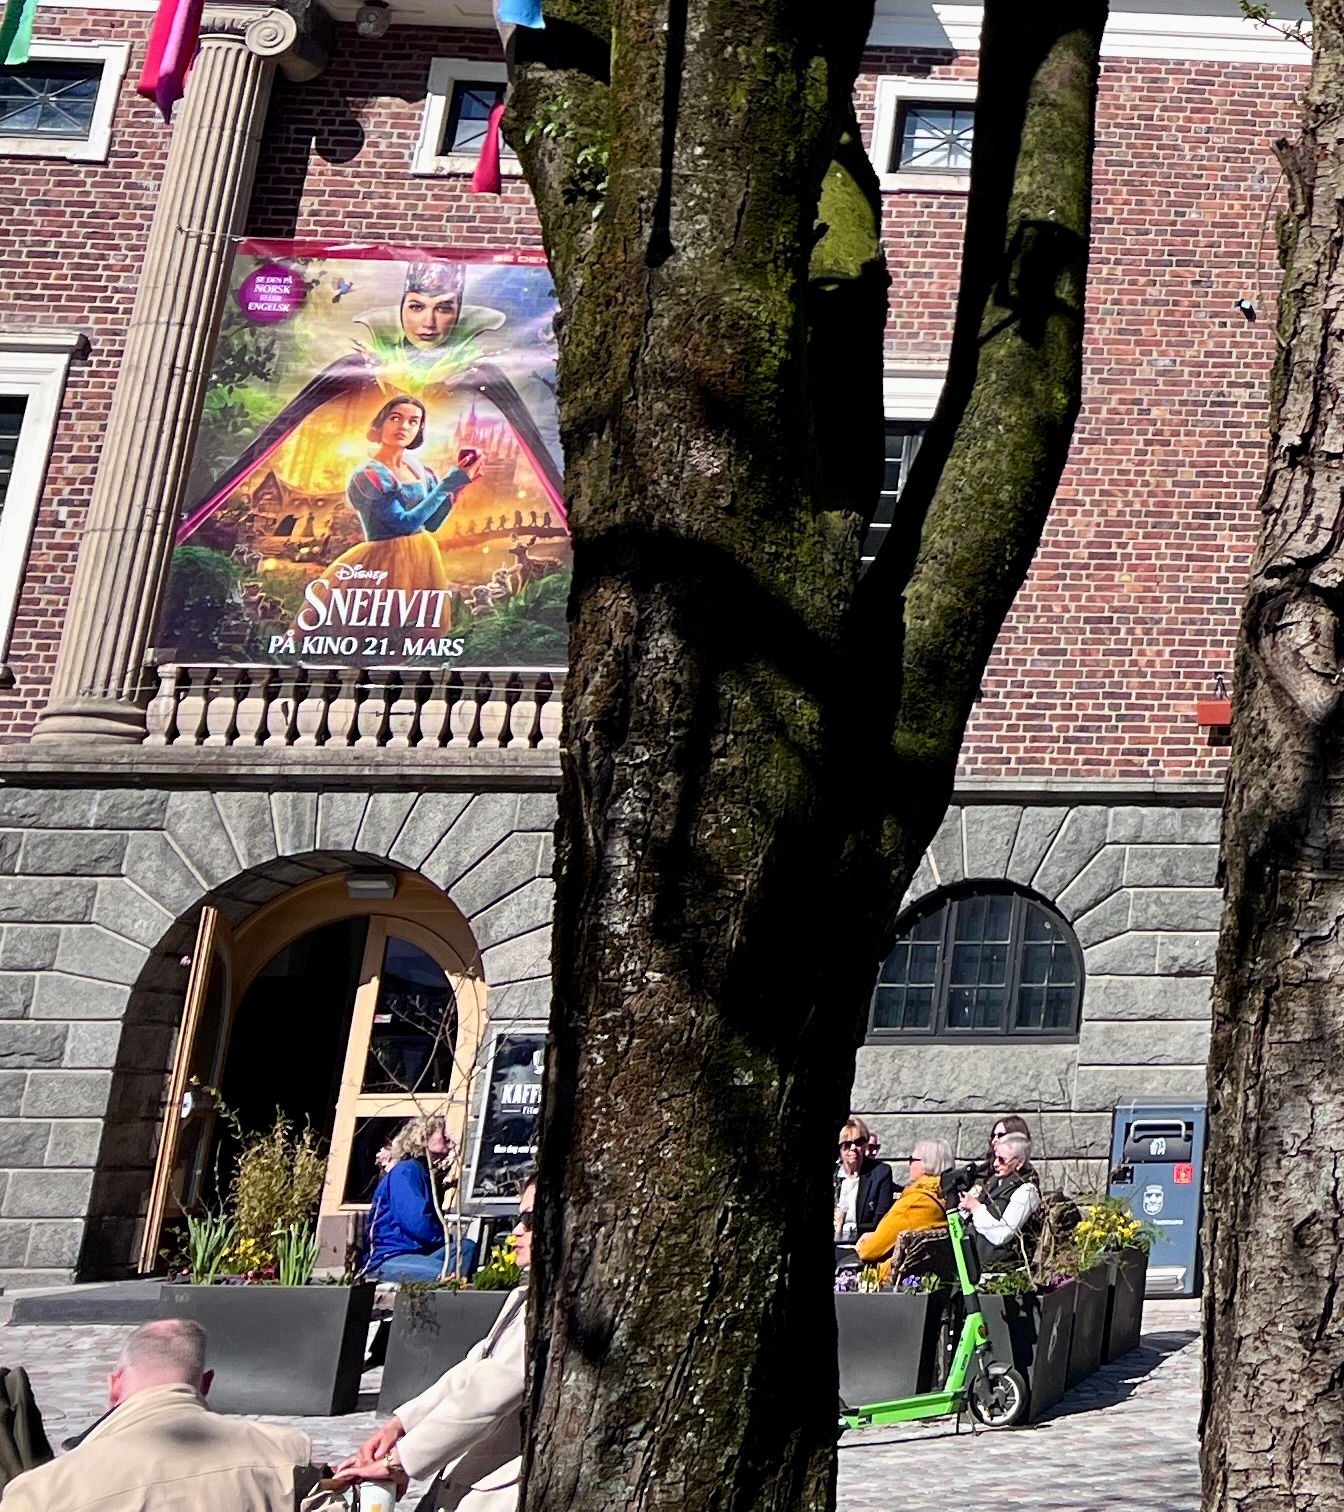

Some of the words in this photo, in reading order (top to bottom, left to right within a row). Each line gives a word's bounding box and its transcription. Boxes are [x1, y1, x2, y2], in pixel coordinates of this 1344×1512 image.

[254, 284, 291, 294] NORSK
[248, 302, 291, 312] ENGELSK
[297, 579, 453, 631] SNEHVIT
[268, 629, 295, 654] PÅ
[302, 636, 358, 655] KINO
[362, 637, 395, 656] 21.
[402, 638, 465, 657] MARS
